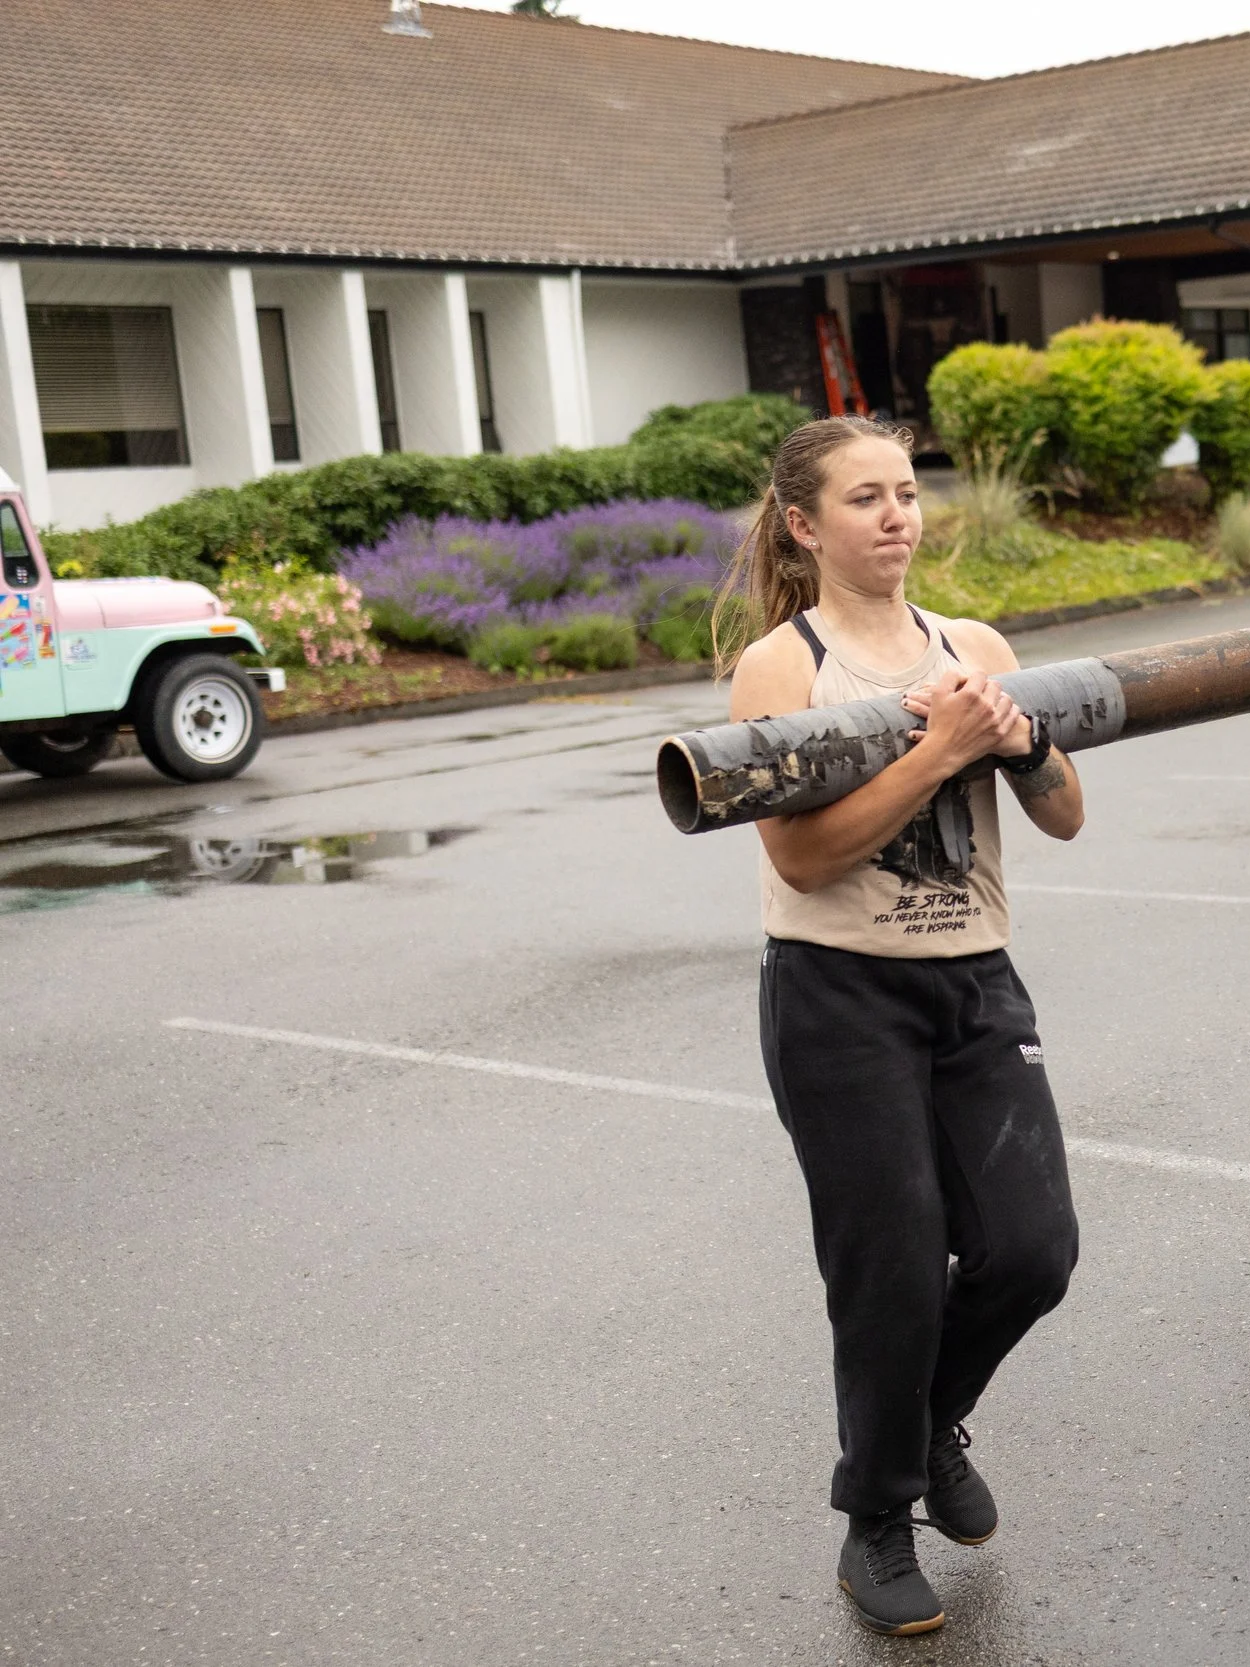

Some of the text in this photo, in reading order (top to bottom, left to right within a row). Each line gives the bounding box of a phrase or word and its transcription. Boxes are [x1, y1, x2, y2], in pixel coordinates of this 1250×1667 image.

[892, 890, 970, 911] BE STRONG
[874, 913, 894, 924] YOU
[895, 910, 928, 923] NEVER
[930, 908, 954, 920] KNOW
[955, 906, 972, 917] WHO
[903, 920, 967, 935] ARE INSPIRING
